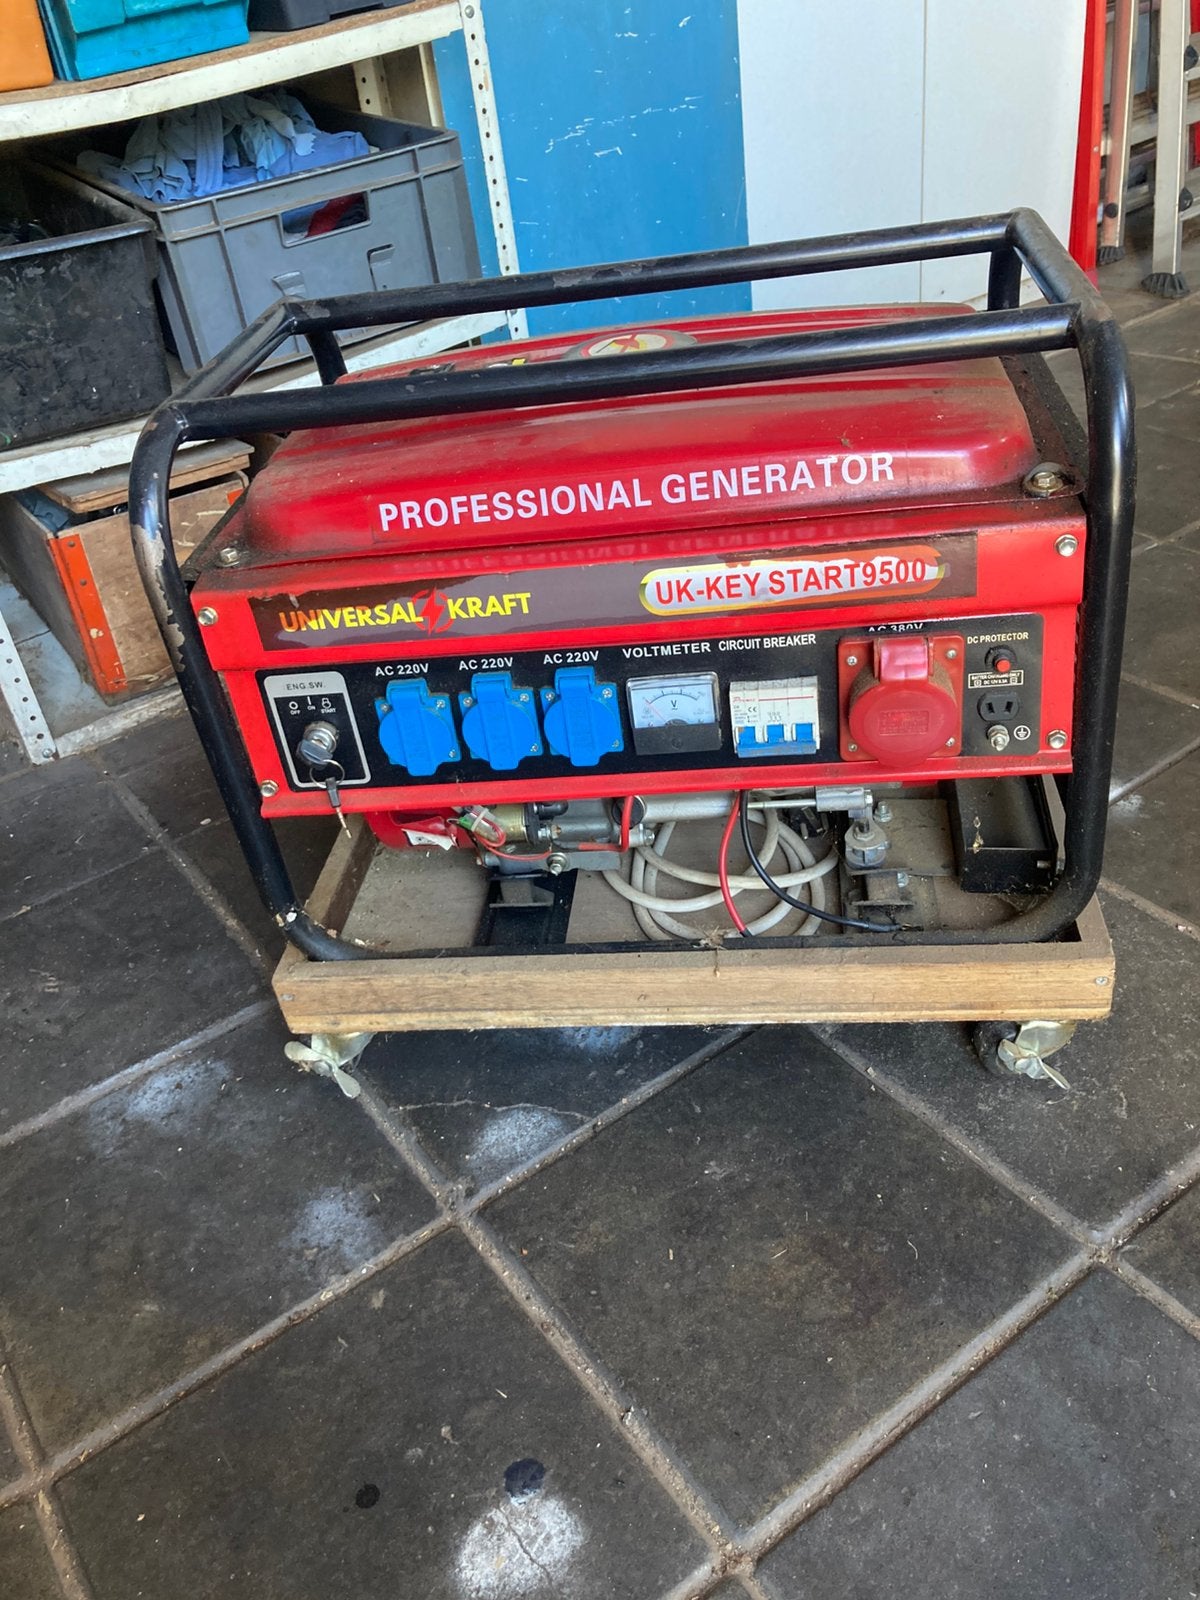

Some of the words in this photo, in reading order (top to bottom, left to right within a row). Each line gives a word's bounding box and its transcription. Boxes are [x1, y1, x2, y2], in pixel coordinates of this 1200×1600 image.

[378, 477, 652, 532] PROFESSIONAL
[660, 451, 895, 505] GENERATOR
[655, 571, 761, 605] UK-KEY
[768, 557, 926, 596] START9500
[279, 600, 424, 633] UNIVERSAL
[447, 592, 532, 620] KRAFT
[718, 638, 762, 652] CIRCUIT
[763, 633, 817, 649] BREAKER
[967, 636, 979, 644] DC
[979, 631, 1029, 643] PROTECTOR
[543, 653, 563, 665] AC
[566, 650, 600, 663] 220V
[622, 641, 711, 660] VOLTMETER
[375, 666, 395, 677] AC
[397, 663, 430, 675] 220V
[458, 660, 479, 671] AC
[481, 656, 514, 669] 220V
